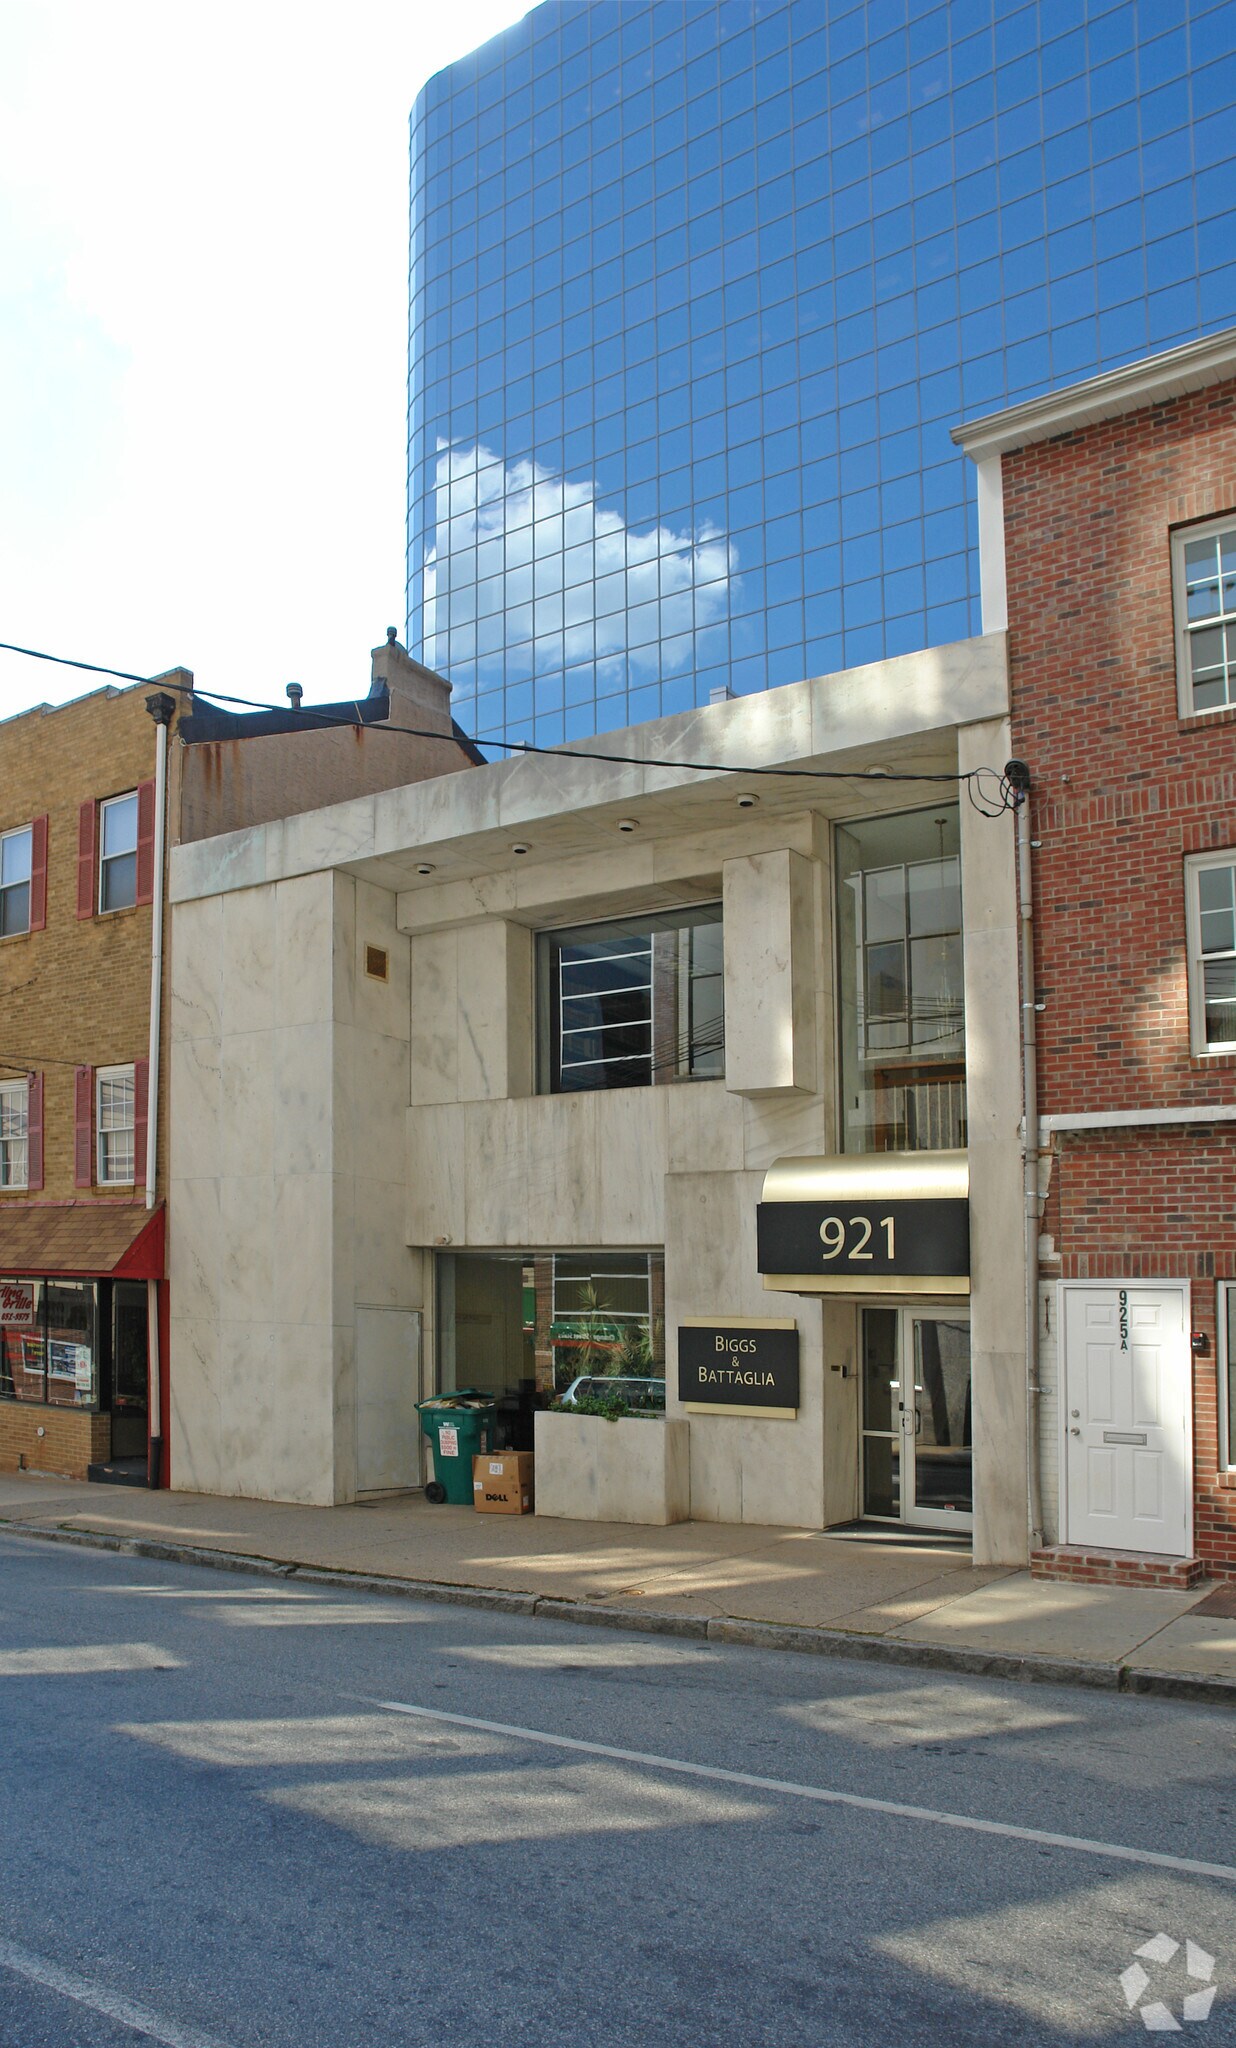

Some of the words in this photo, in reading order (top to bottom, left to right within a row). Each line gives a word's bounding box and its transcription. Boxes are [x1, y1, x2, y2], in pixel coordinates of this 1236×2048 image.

[819, 1216, 895, 1260] 921
[2, 1296, 32, 1309] Grille
[1119, 1290, 1128, 1350] 925A
[715, 1335, 757, 1353] BIGGS
[731, 1355, 740, 1367] &
[698, 1366, 775, 1386] BATTAGLIA
[485, 1493, 508, 1502] DELL
